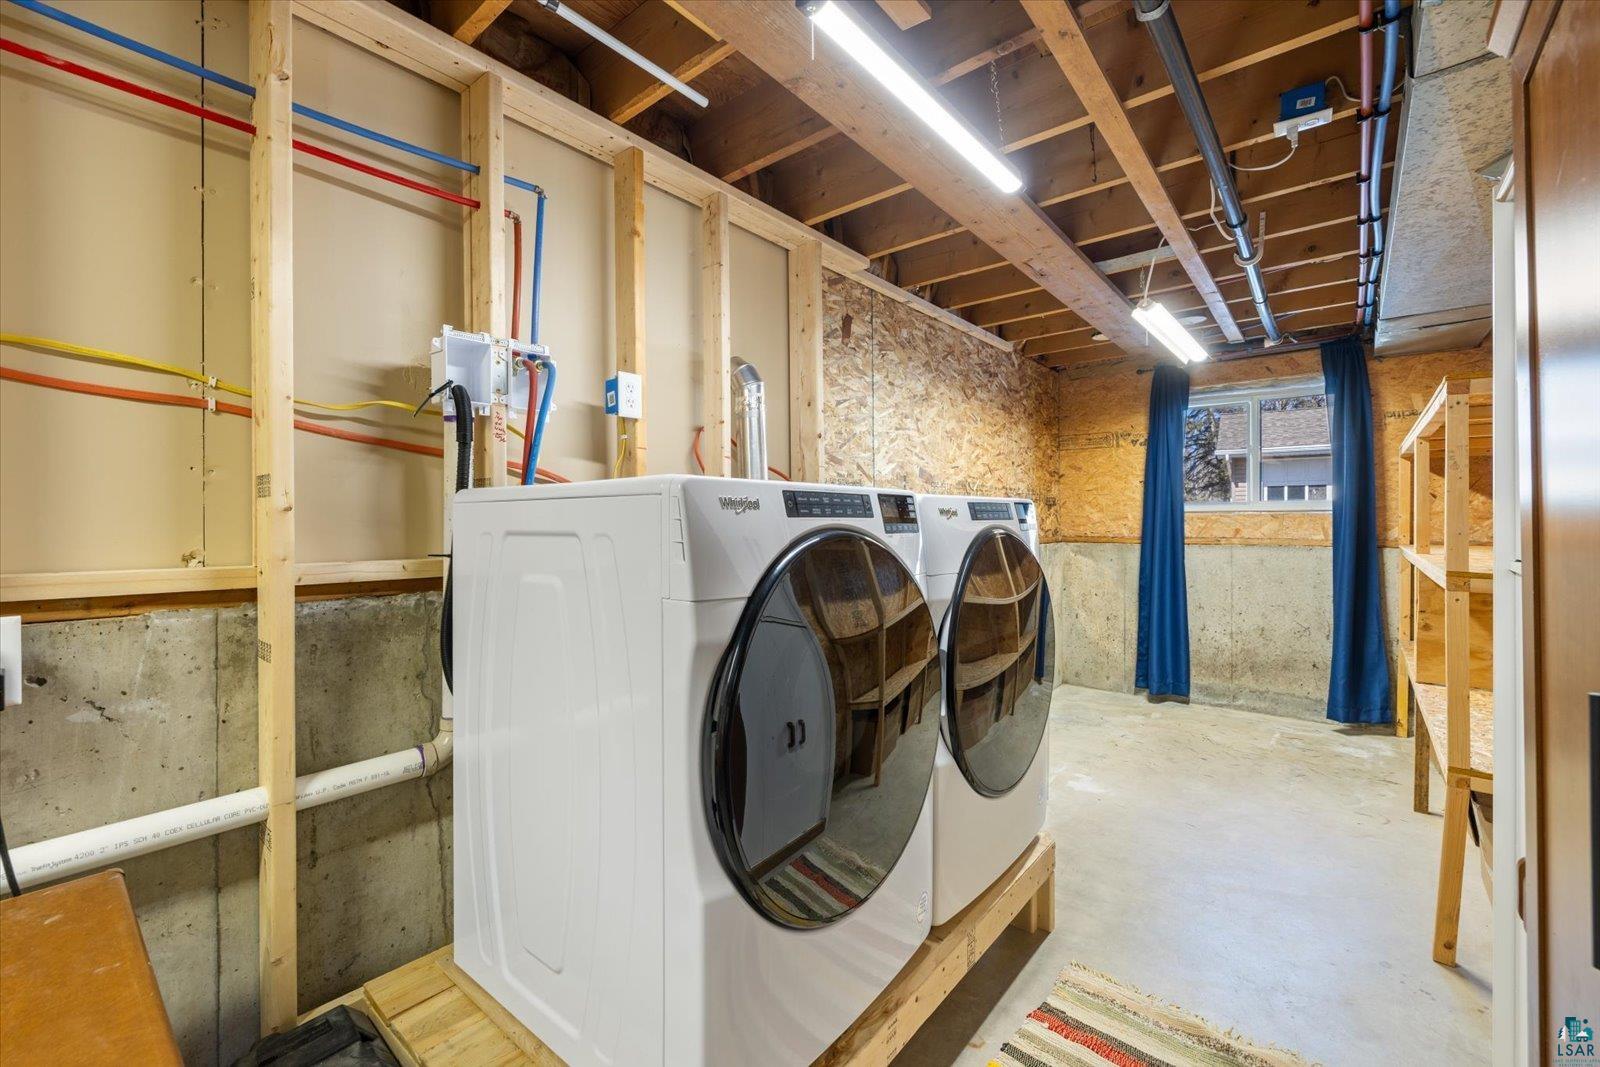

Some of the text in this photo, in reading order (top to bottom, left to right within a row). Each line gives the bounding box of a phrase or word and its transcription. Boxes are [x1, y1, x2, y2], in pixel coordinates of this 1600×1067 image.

[718, 496, 760, 515] Whirlpool
[74, 850, 95, 861] 4200
[164, 825, 184, 836] COEX
[223, 810, 241, 821] CORE
